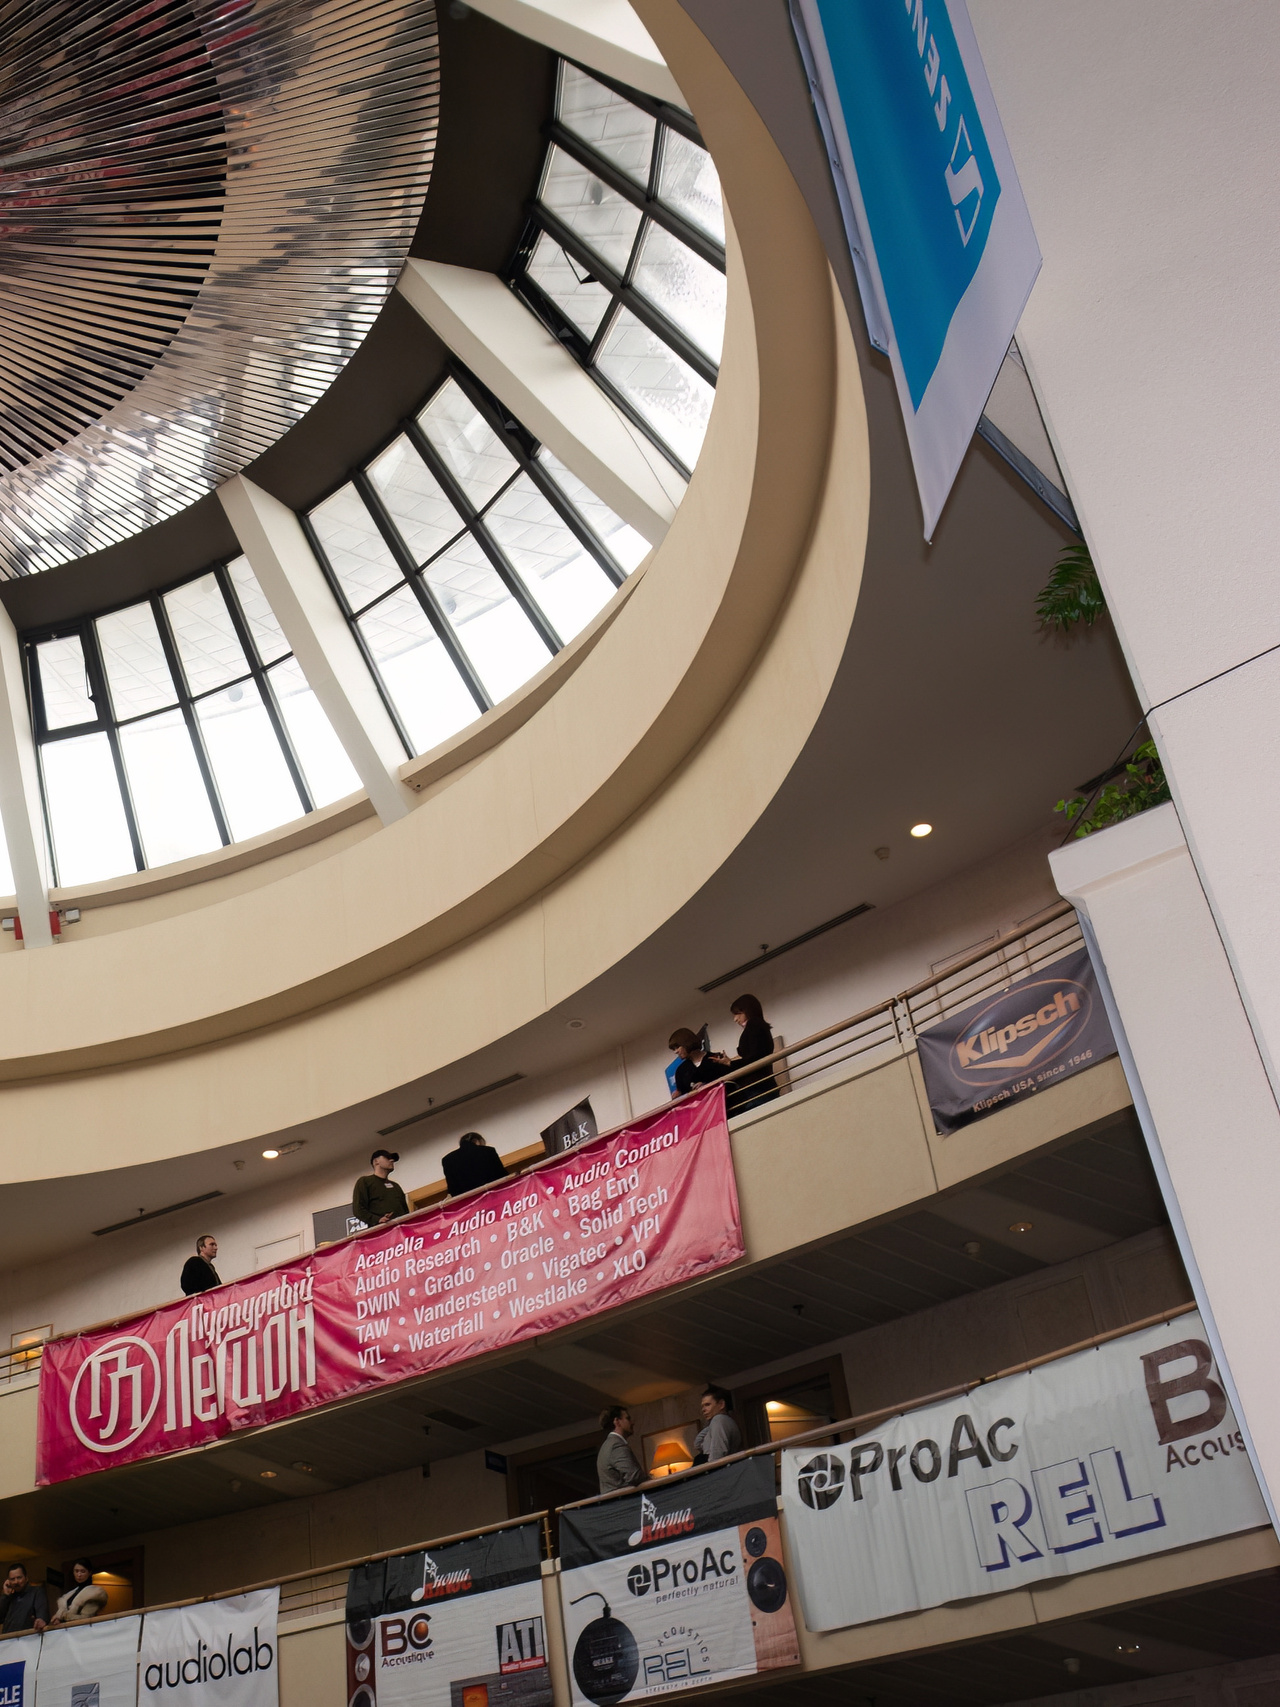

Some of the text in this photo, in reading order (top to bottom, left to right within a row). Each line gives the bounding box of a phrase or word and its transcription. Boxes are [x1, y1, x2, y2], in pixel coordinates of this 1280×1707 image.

[955, 991, 1081, 1067] Klipsch
[973, 1049, 1093, 1112] Klipsch USA since 1946
[563, 1121, 590, 1150] B&K
[355, 1126, 679, 1272] Acapella Audio Aero Audio Control
[355, 1170, 640, 1295] Audio Research B&K Bag End
[355, 1214, 660, 1344] TAW Vandersteen Vigatec VPI
[357, 1186, 668, 1320] DWIN Grado Oracle Solid Tech
[191, 1267, 314, 1348] Пурпурный
[358, 1250, 646, 1370] VTL Waterfall Westlake XLO
[164, 1302, 316, 1432] Легион
[1140, 1338, 1228, 1445] B
[850, 1414, 1018, 1501] ProAc
[965, 1446, 1166, 1571] REL
[652, 1547, 736, 1592] ProAc
[656, 1575, 738, 1604] perfectly natural
[145, 1626, 273, 1691] audiolab
[380, 1613, 433, 1657] BC
[381, 1650, 434, 1668] Acoustique
[500, 1618, 544, 1665] ATI
[643, 1648, 710, 1685] REL
[657, 1626, 709, 1663] ACOUSTICS
